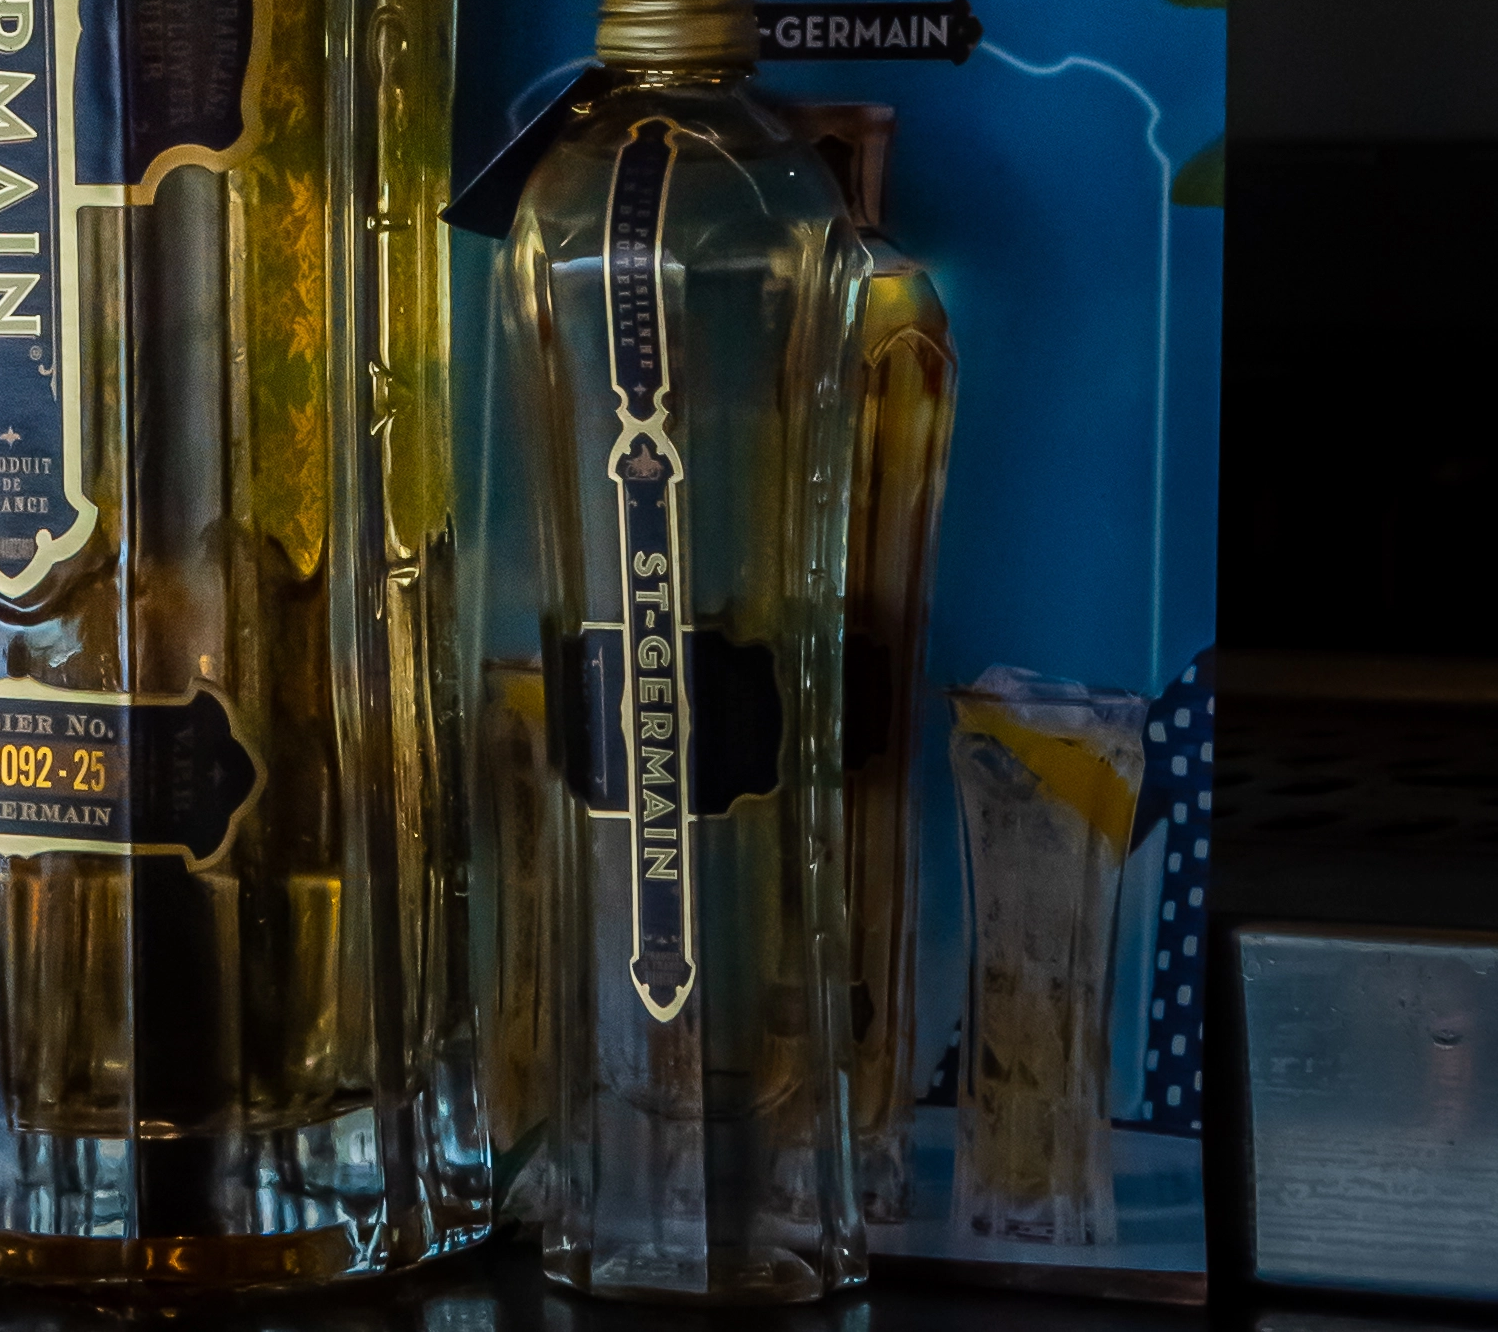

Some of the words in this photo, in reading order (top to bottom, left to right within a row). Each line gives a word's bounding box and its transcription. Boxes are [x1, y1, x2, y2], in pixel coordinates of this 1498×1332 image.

[616, 204, 636, 348] BOUTEILLE
[633, 226, 654, 371] PARISIENNE
[1, 477, 22, 492] DE
